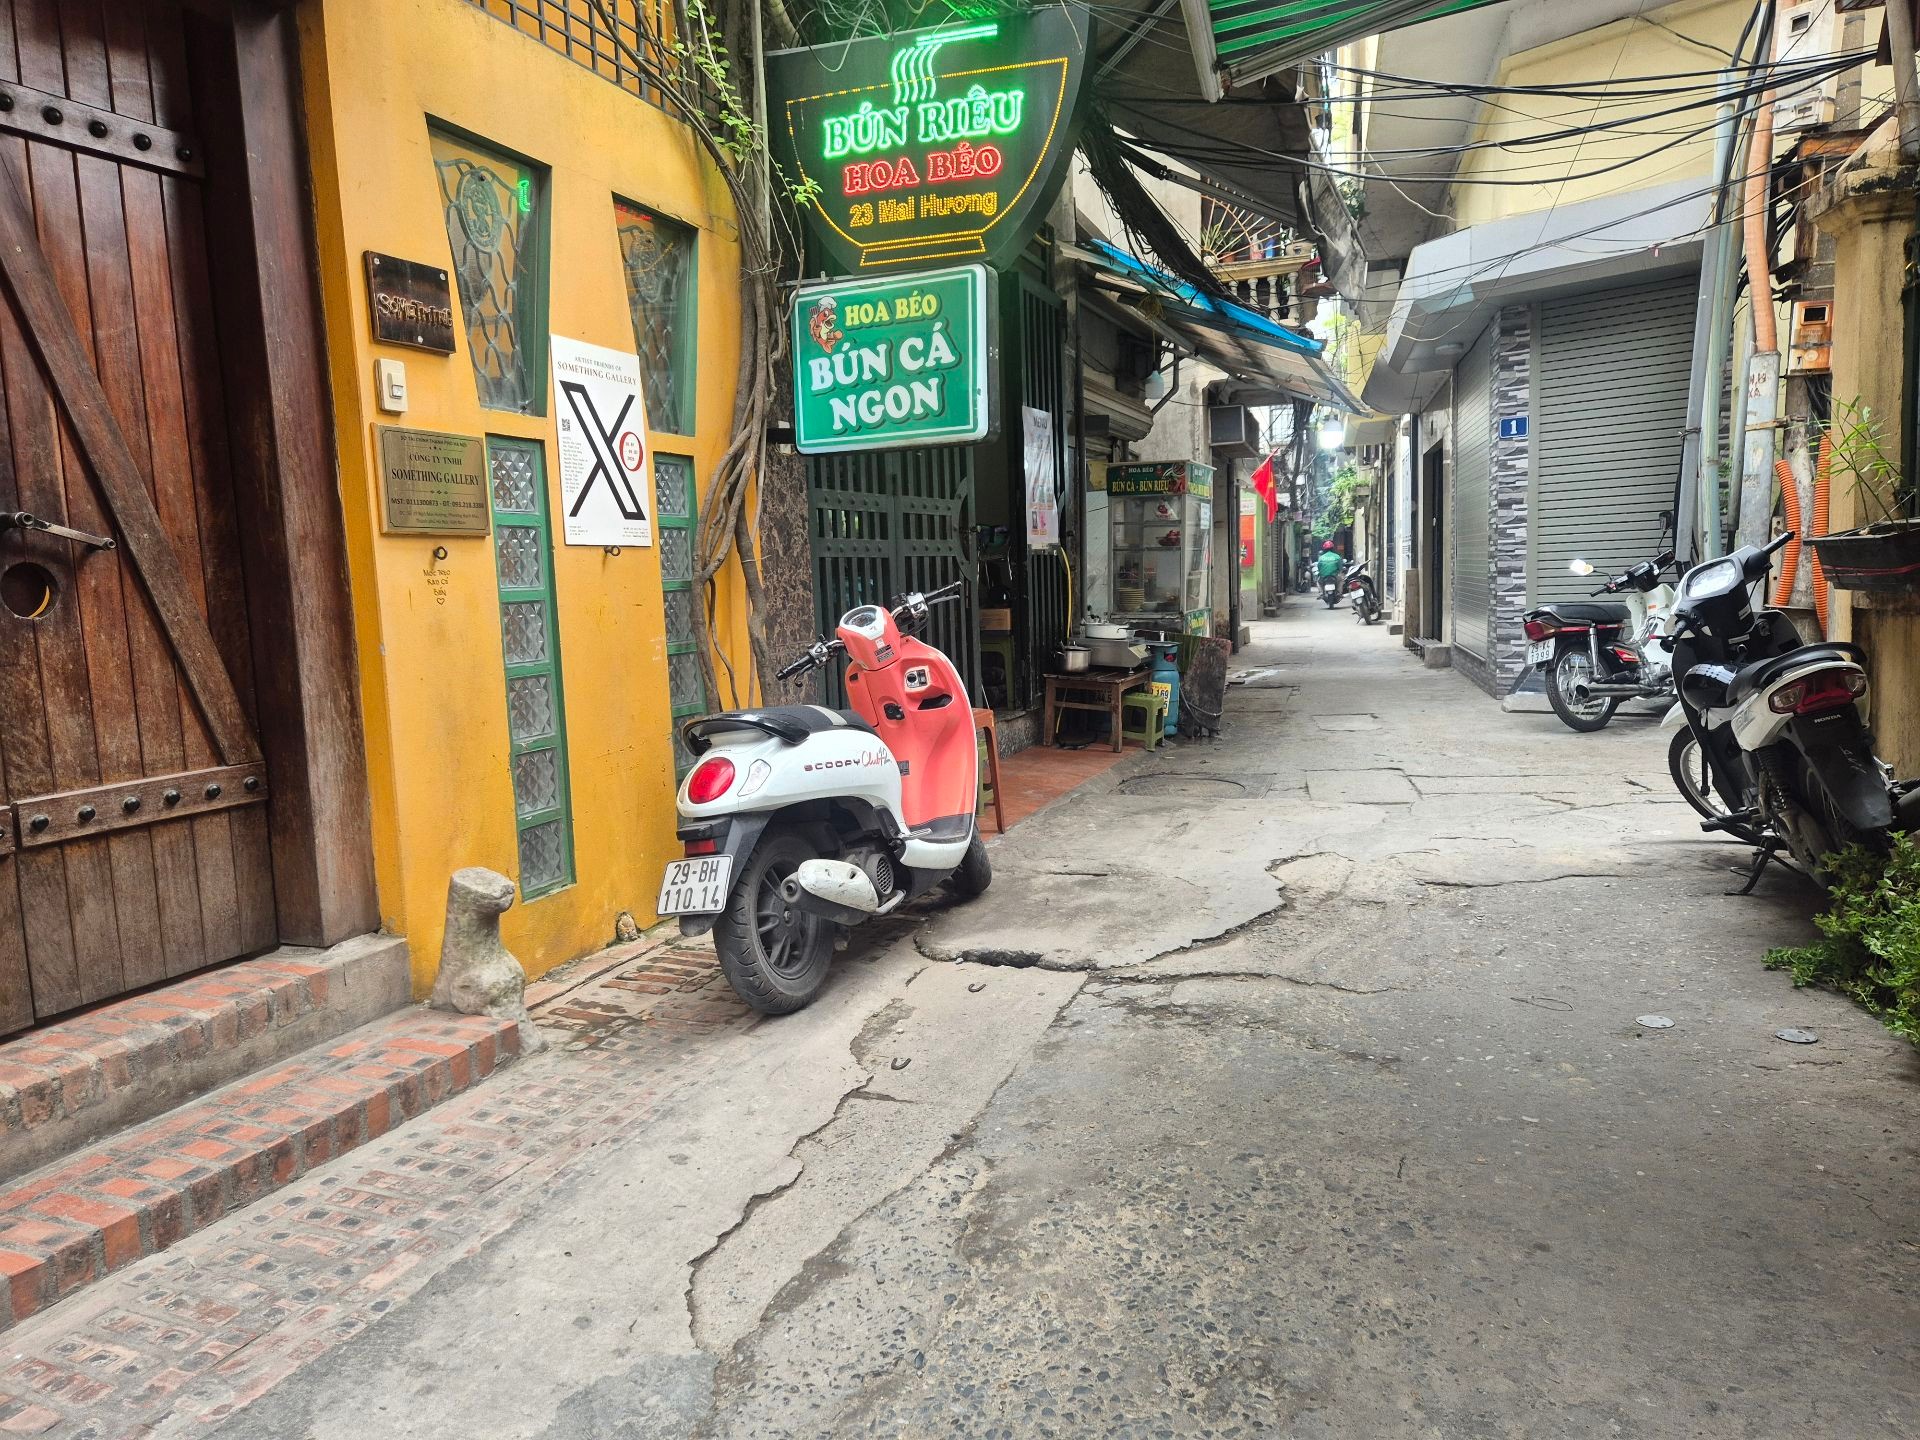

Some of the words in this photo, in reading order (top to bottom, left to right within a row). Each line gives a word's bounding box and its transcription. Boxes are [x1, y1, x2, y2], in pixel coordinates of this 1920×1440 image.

[824, 102, 909, 158] BÚN
[918, 84, 1024, 142] RIÊU
[844, 157, 920, 193] HOA
[928, 142, 1001, 181] BÉO
[849, 204, 873, 227] 23
[845, 301, 889, 326] HOA
[895, 290, 937, 319] BÉO
[808, 342, 887, 391] BÚN
[900, 322, 956, 371] CÁ
[557, 361, 604, 378] SOMETHING
[605, 372, 637, 385] GALLERY
[829, 378, 939, 430] NGON
[1510, 420, 1517, 434] 1
[443, 456, 462, 465] TNHH
[391, 468, 442, 482] SOMETHING
[443, 472, 480, 486] GALLERY
[1139, 478, 1153, 491] BÚN
[1814, 714, 1842, 724] HONDA
[804, 759, 861, 772] SCOOPY
[670, 859, 720, 886] 29-BH
[664, 885, 720, 911] 110.14
